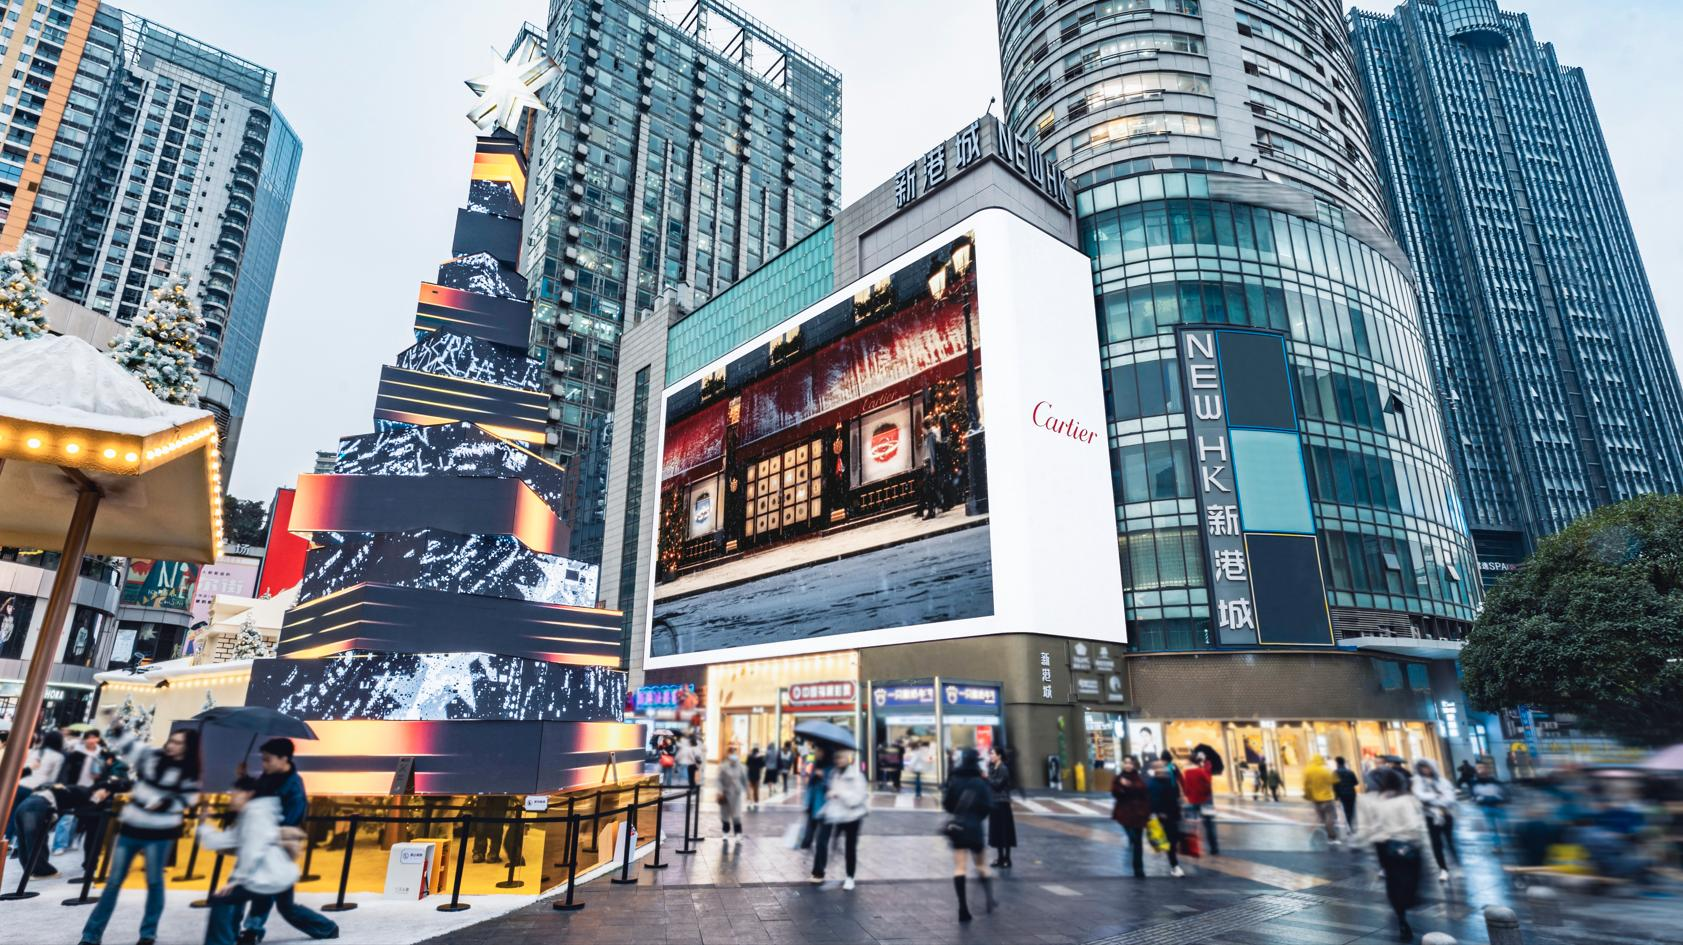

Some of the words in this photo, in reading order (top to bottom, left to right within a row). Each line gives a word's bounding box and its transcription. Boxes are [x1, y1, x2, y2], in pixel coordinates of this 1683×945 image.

[895, 120, 981, 208] 新港城
[1186, 333, 1222, 420] NEW
[1033, 401, 1098, 444] Cartier
[1198, 436, 1231, 493] HK
[1207, 504, 1255, 630] 新港城
